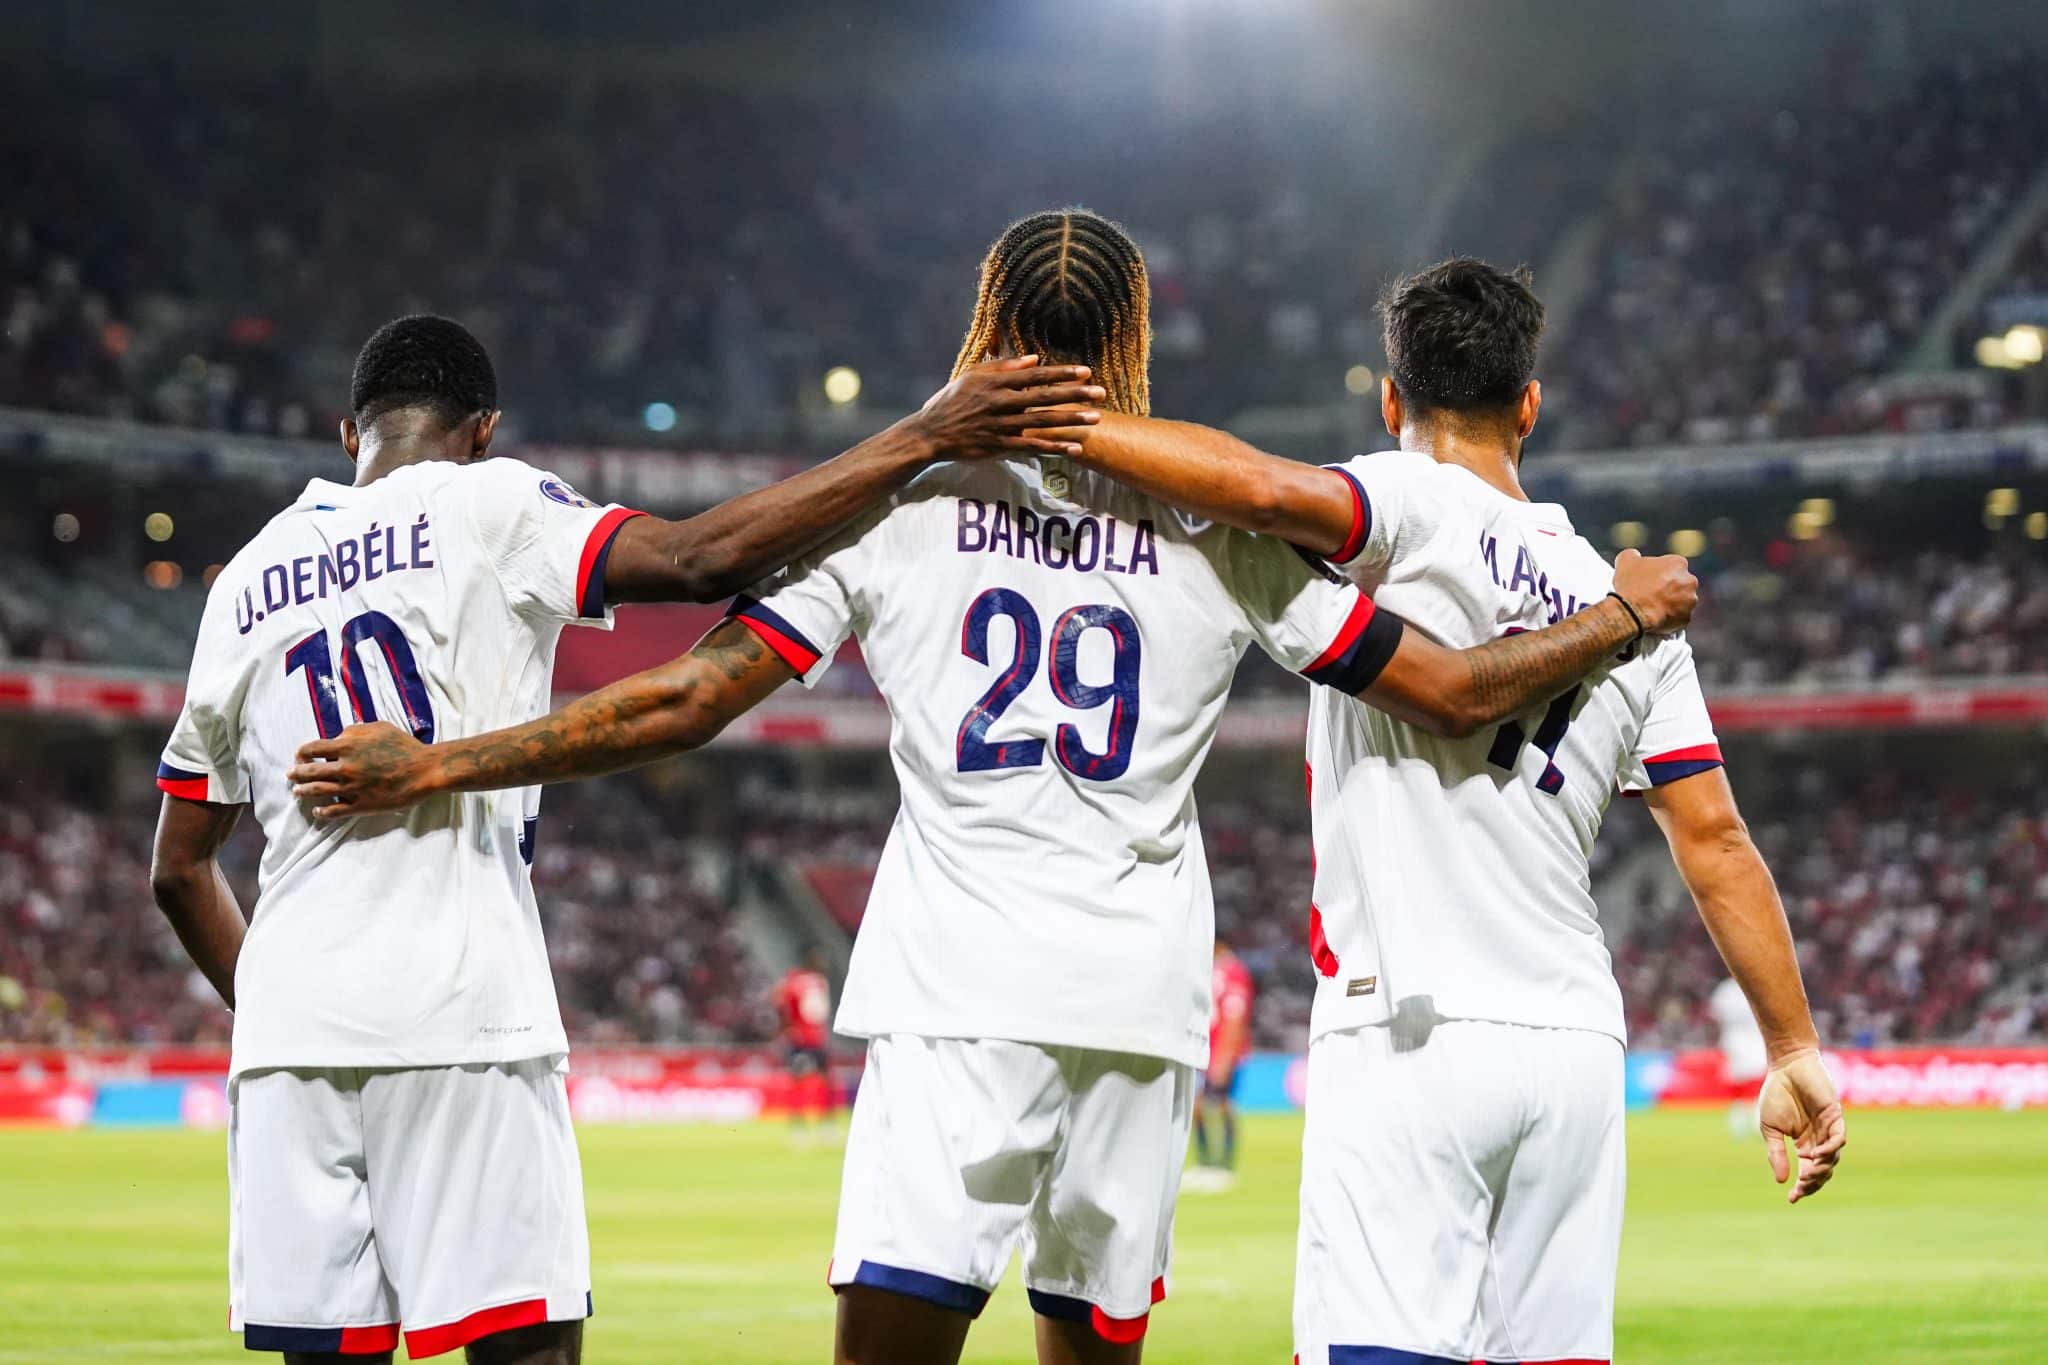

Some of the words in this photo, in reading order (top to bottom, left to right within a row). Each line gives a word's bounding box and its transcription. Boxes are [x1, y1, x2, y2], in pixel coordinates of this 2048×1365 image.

[957, 498, 1159, 575] BARCOLA
[286, 610, 434, 745] 10
[957, 587, 1141, 781] 29
